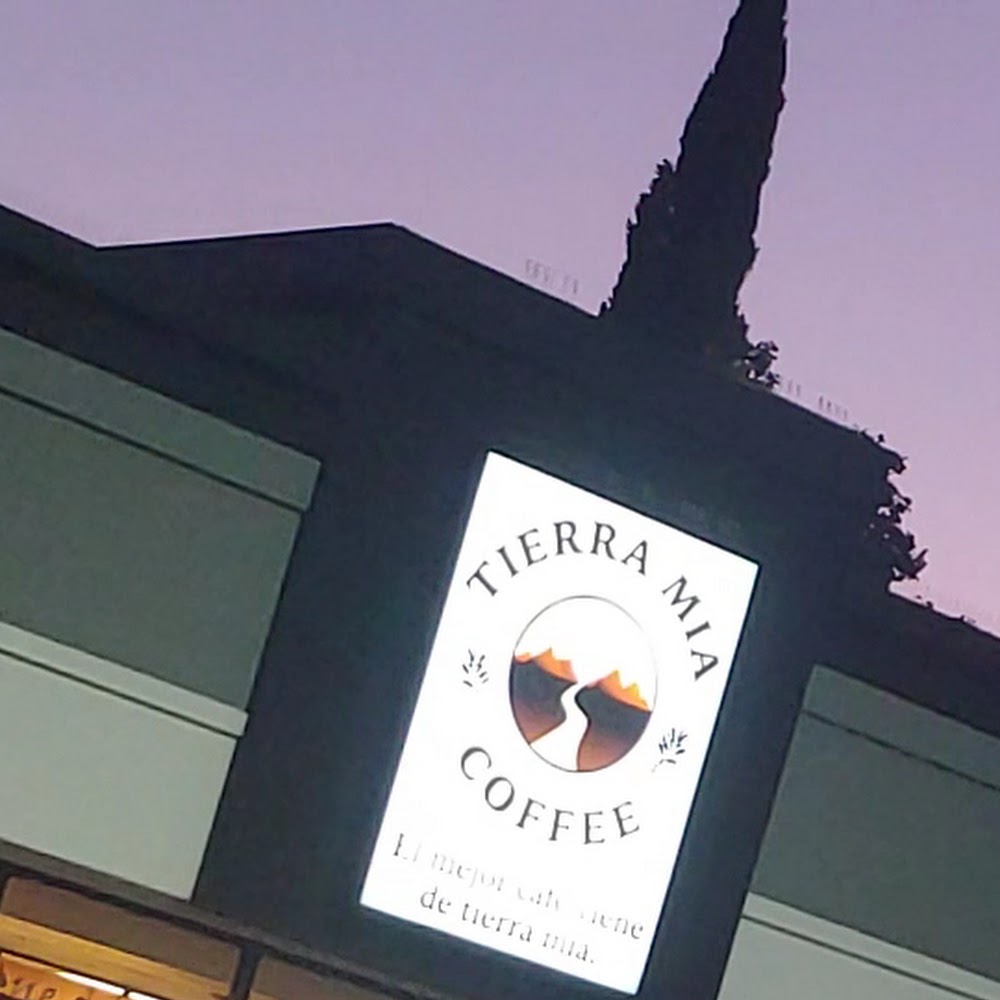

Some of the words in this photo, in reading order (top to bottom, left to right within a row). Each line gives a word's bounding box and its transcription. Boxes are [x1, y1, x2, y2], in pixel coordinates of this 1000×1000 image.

[465, 520, 649, 598] TIERRA
[660, 575, 720, 682] MIA
[460, 746, 641, 846] COFFEE
[420, 886, 453, 916] de
[461, 902, 533, 944] tierra
[578, 910, 645, 941] iene
